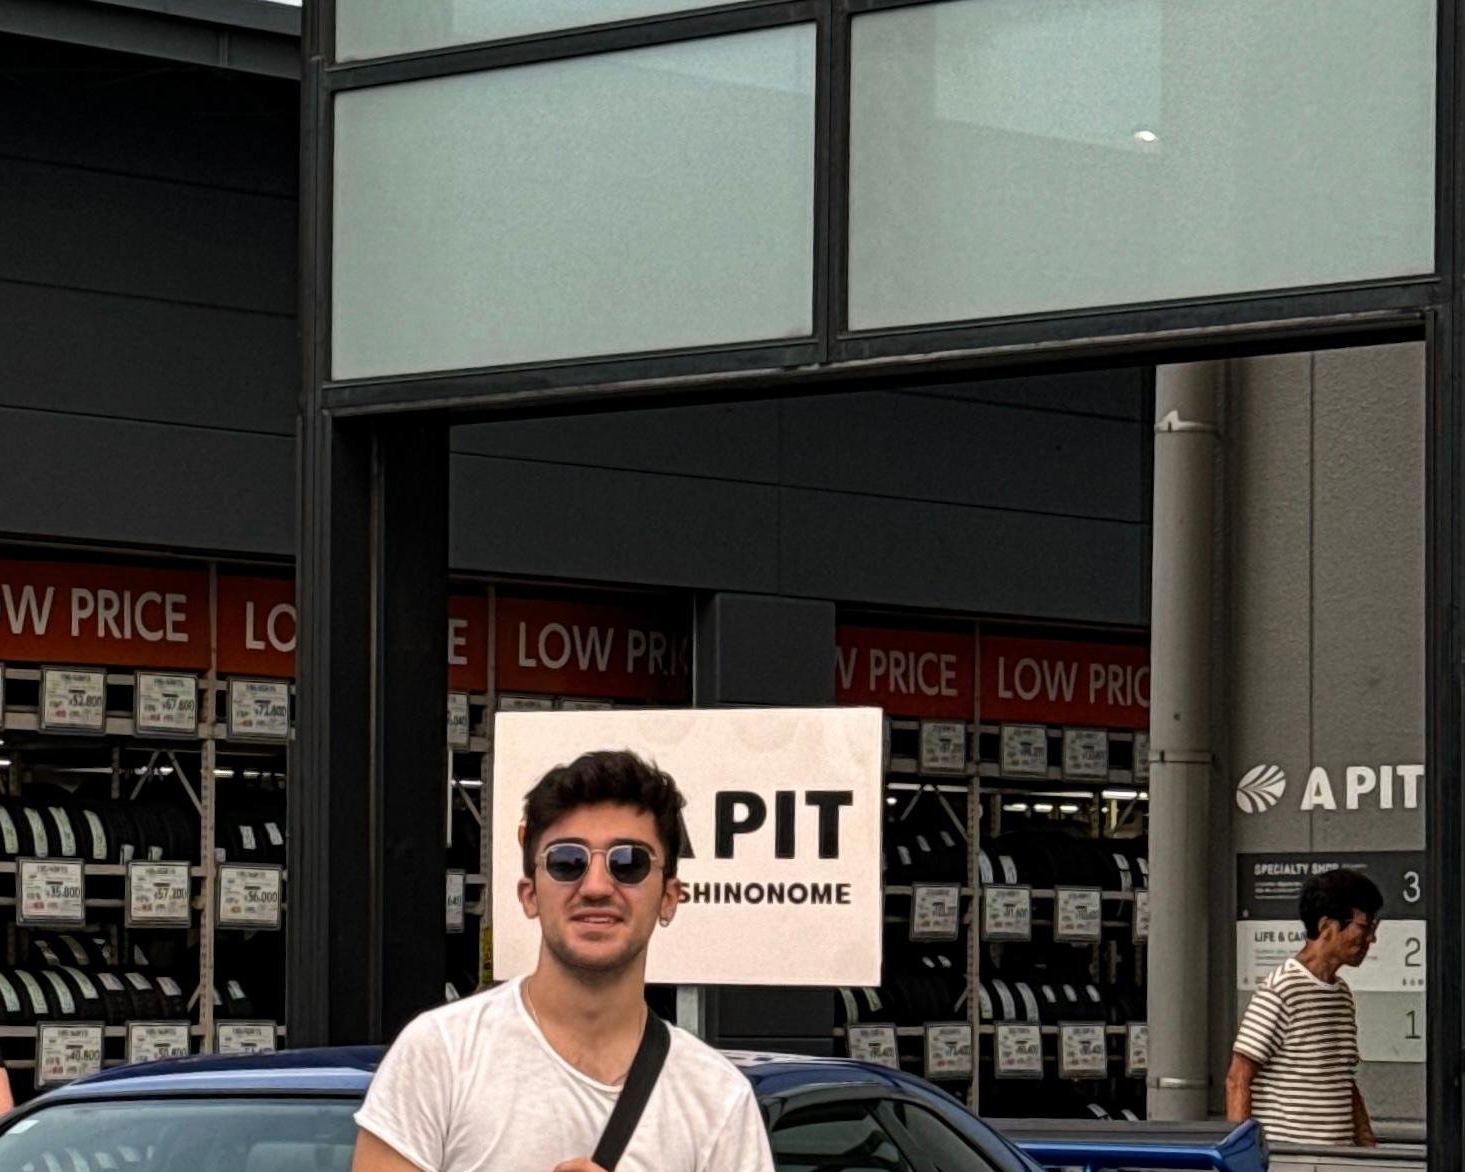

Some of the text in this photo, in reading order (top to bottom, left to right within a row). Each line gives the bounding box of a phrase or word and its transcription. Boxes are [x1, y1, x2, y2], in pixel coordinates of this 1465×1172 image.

[70, 587, 189, 643] PRICE
[245, 601, 296, 653] LO
[518, 620, 614, 672] LOW
[869, 648, 958, 697] PRICE
[998, 656, 1150, 708] LOW PRIC
[1300, 764, 1425, 810] A PIT
[714, 790, 854, 859] PIT
[1254, 863, 1310, 876] SPECIALTY
[1402, 871, 1421, 903] 3
[679, 882, 852, 904] SHINONOME
[1254, 931, 1275, 943] LIFE
[1404, 937, 1421, 967] 2
[1404, 1010, 1421, 1040] 1
